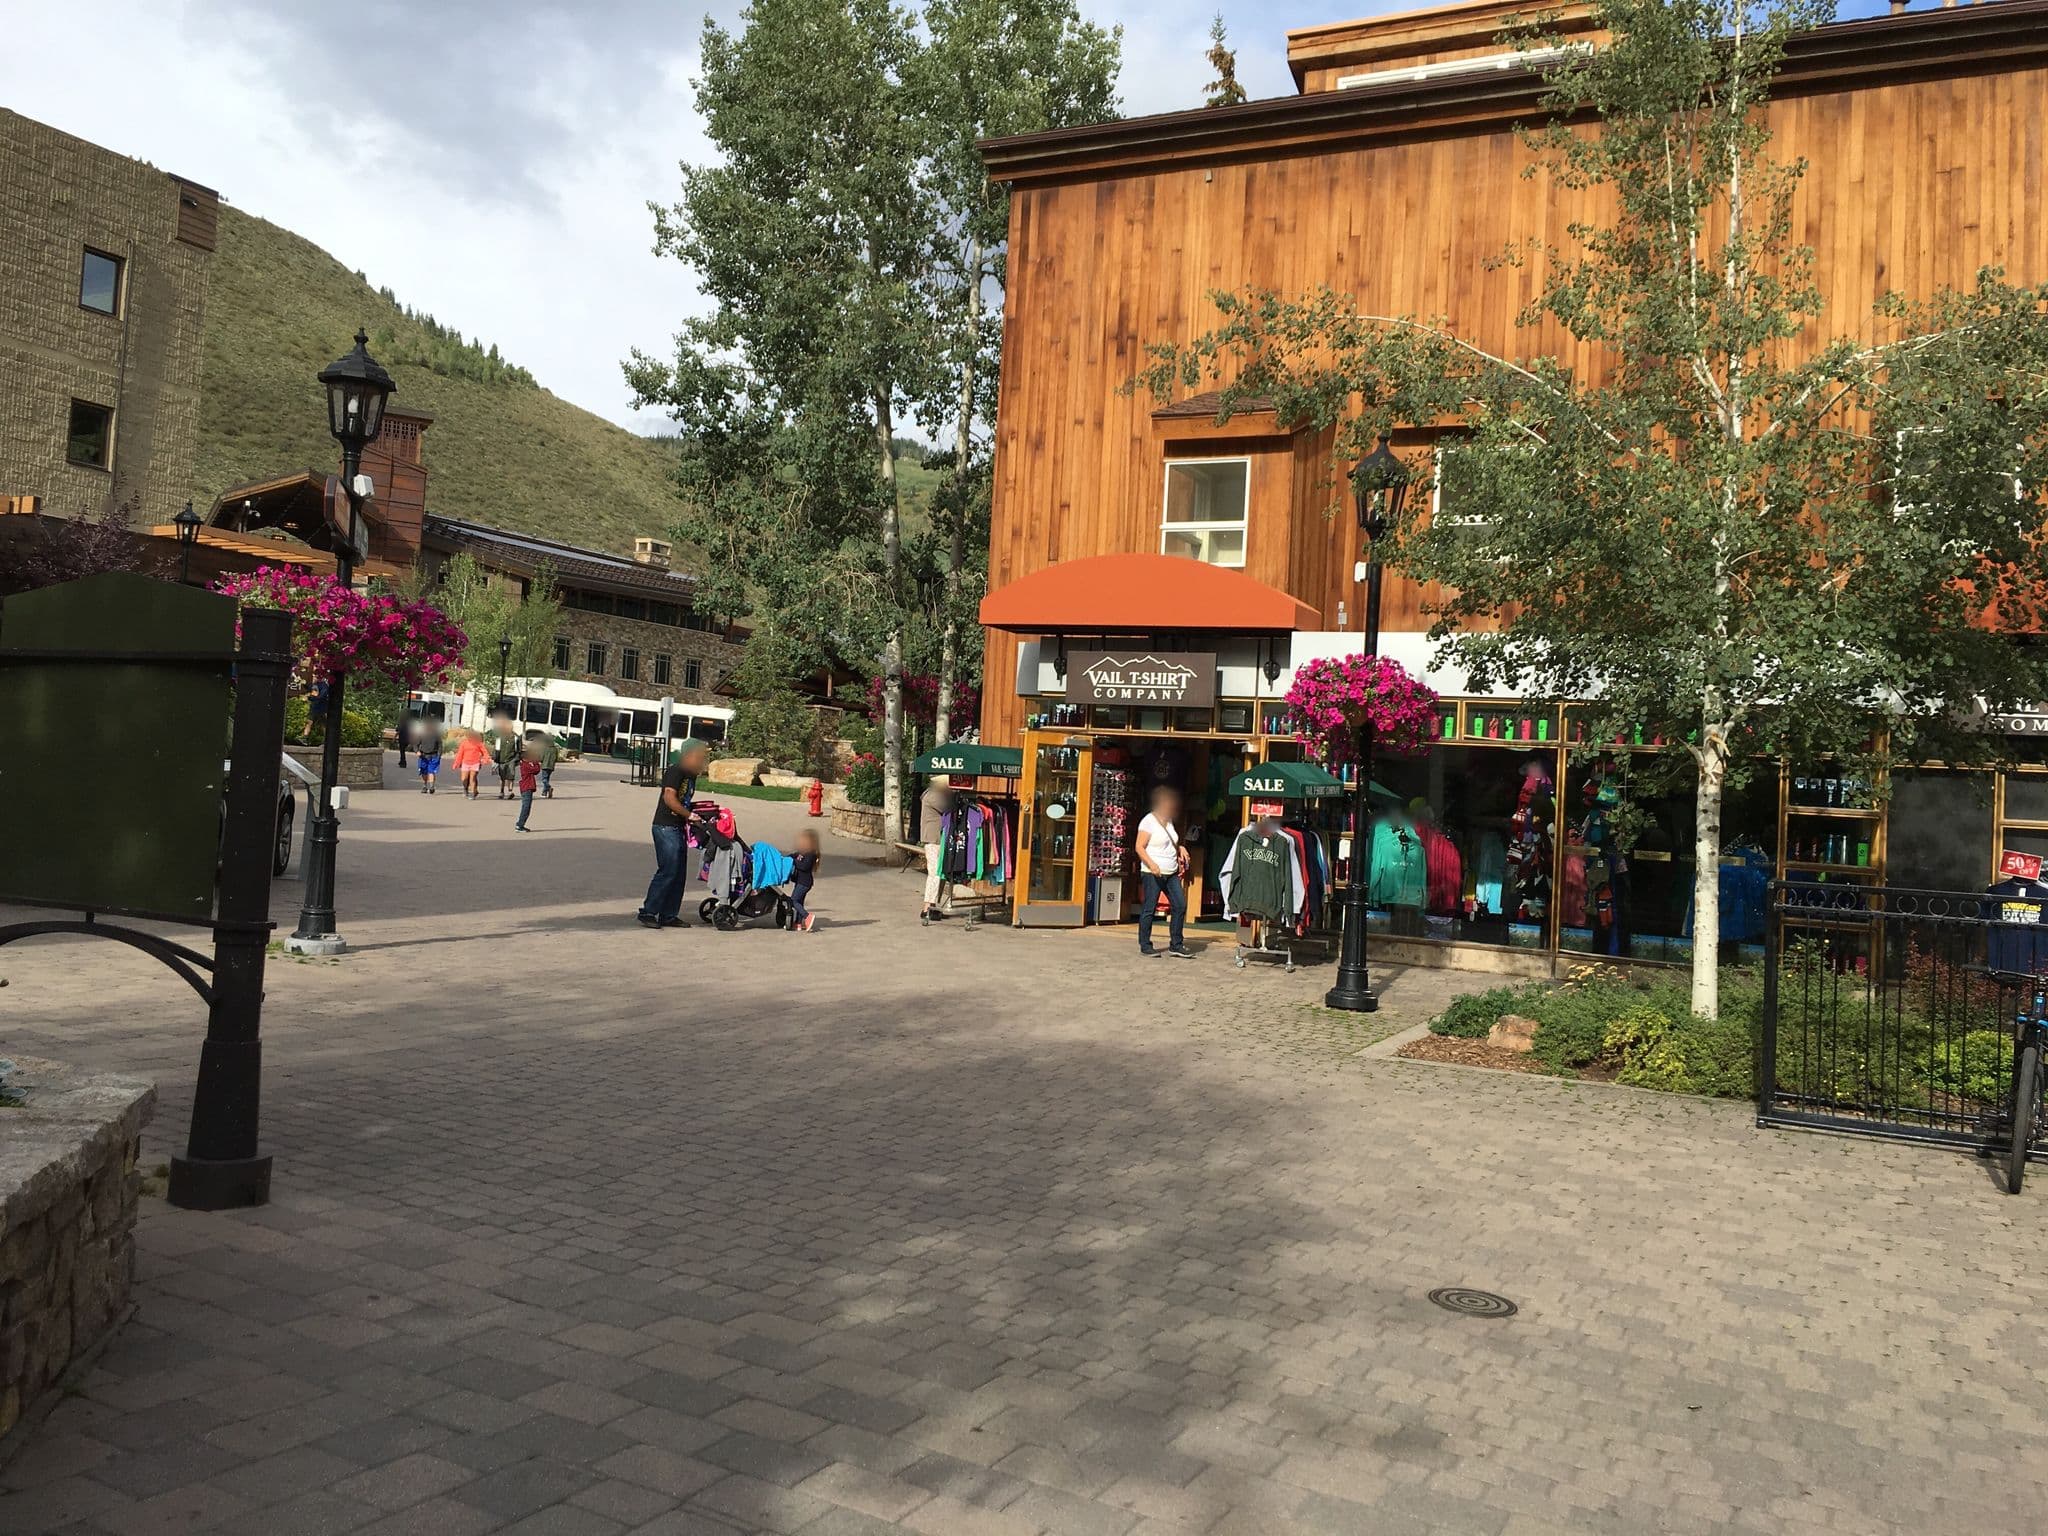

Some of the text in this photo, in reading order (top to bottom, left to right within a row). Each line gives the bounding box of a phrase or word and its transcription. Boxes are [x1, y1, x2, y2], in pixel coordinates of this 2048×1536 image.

[1088, 671, 1191, 689] VAIL T-SHIRT
[1093, 688, 1184, 700] COMPANY
[931, 757, 964, 770] SALE
[1244, 778, 1284, 792] SALE
